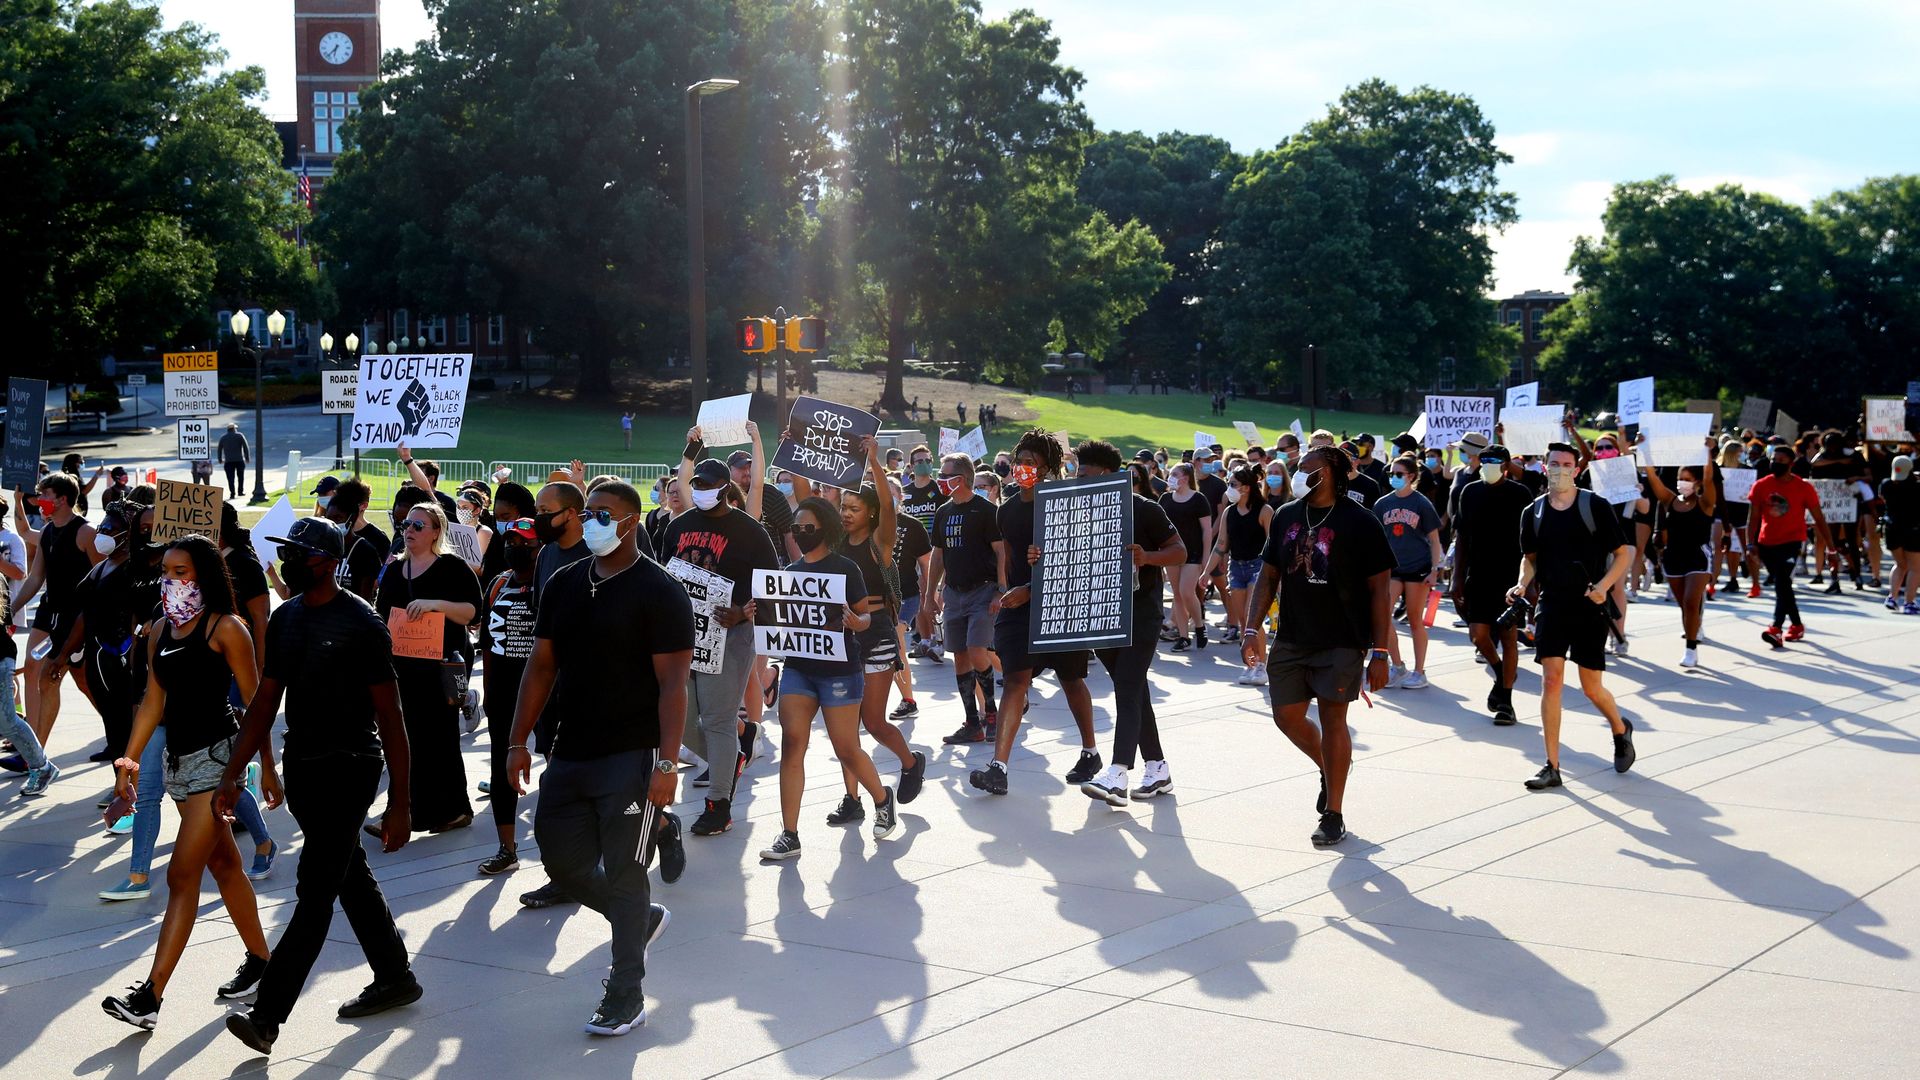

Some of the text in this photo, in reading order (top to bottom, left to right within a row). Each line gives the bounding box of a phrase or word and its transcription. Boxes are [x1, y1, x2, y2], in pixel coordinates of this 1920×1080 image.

[167, 354, 214, 369] NOTICE
[365, 357, 465, 381] TOGETHER
[180, 375, 202, 385] THRU
[329, 375, 349, 384] ROAD
[175, 387, 208, 398] TRUCKS
[365, 388, 393, 406] WE
[434, 390, 462, 401] BLACK
[166, 400, 217, 411] PROHIBITED
[324, 400, 354, 409] NO THRU
[432, 404, 459, 414] LIVES
[1451, 399, 1491, 414] NEVER
[185, 424, 202, 432] NO
[426, 416, 461, 429] MATTER
[811, 409, 853, 436] STOP
[182, 435, 205, 444] THRU
[352, 422, 403, 444] STAND
[804, 426, 849, 454] POLICE
[181, 447, 207, 455] TRAFFIC
[791, 444, 855, 479] BRUTALITY
[159, 481, 216, 509] BLACK
[1045, 491, 1122, 512] BLACK LIVES MATTER.
[162, 505, 214, 526] LIVES
[946, 515, 964, 525] JUST
[1045, 505, 1122, 526] BLACK LIVES MATTER.
[1044, 519, 1122, 539] BLACK LIVES MATTER.
[1044, 532, 1122, 553] BLACK LIVES MATTER.
[1044, 546, 1122, 566] BLACK LIVES MATTER.
[1043, 560, 1122, 580] BLACK LIVES MATTER.
[765, 574, 832, 599] BLACK
[1042, 574, 1122, 593] BLACK LIVES MATTER.
[1042, 588, 1122, 607] BLACK LIVES MATTER.
[774, 602, 827, 626] LIVES
[1041, 602, 1121, 620] BLACK LIVES MATTER.
[488, 610, 506, 656] AM
[1040, 616, 1121, 634] BLACK LIVES MATTER.
[765, 630, 835, 656] MATTER
